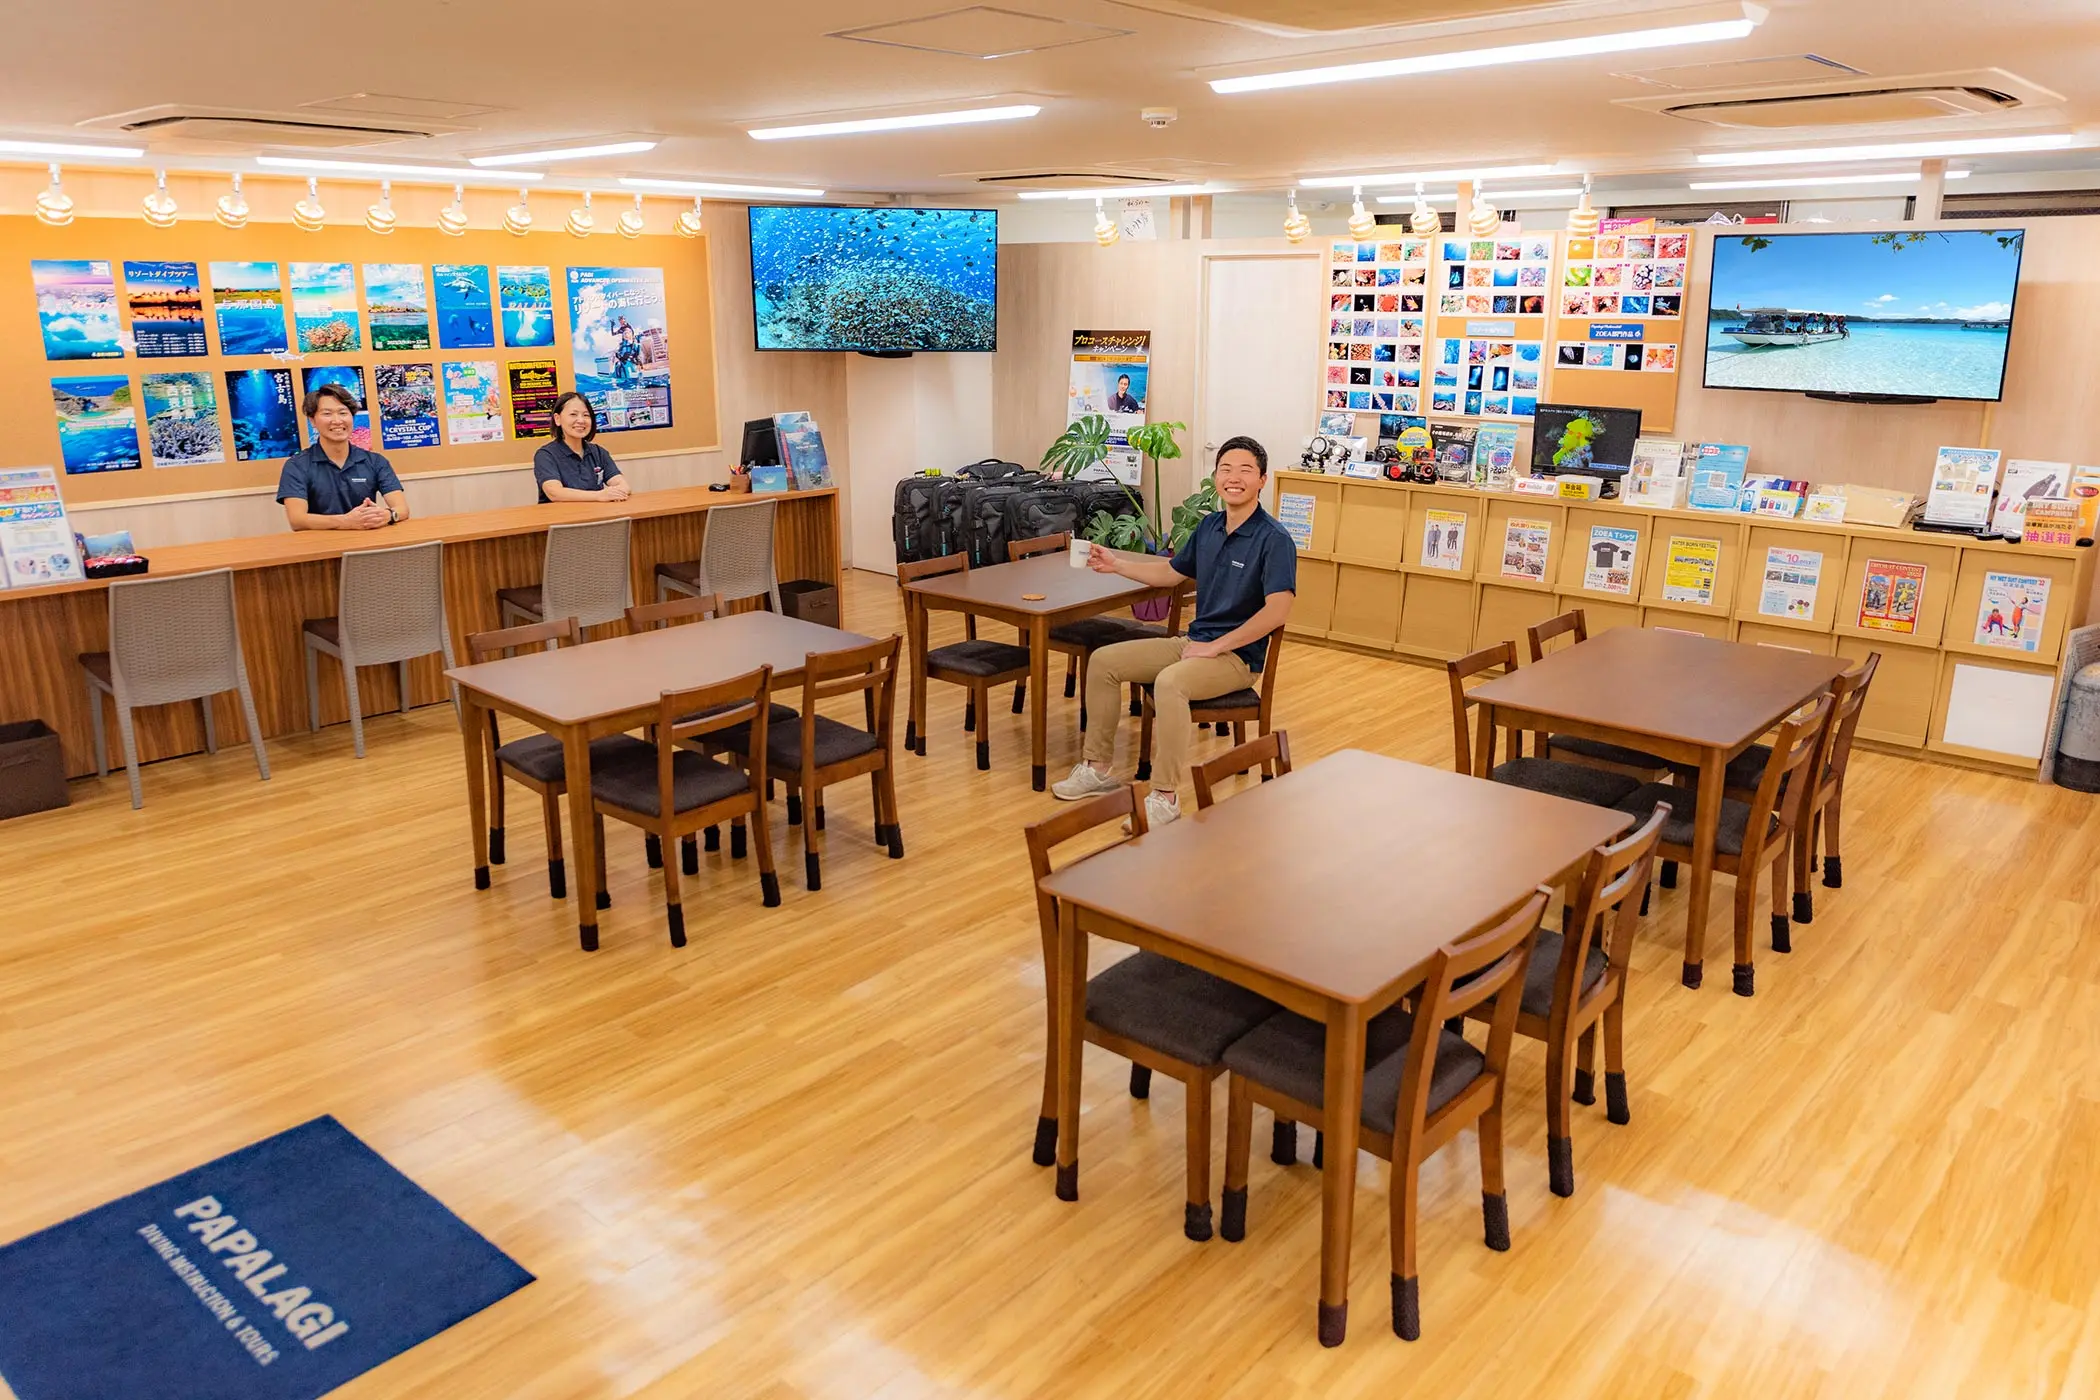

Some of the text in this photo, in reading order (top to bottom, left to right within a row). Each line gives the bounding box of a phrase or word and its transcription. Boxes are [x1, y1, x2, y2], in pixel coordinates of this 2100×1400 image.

[128, 270, 195, 279] リゾートダイブツアー
[1092, 345, 1128, 353] キャンペーン
[274, 372, 288, 405] 宮古島
[388, 425, 418, 434] CRYSTAL
[1593, 530, 1613, 538] ZOEA
[2025, 530, 2071, 544] 抽選箱
[173, 1195, 349, 1351] PAPALAGI
[136, 1223, 181, 1261] DIVING
[168, 1254, 238, 1322] INSTRUCTION
[234, 1324, 281, 1367] TOURS
